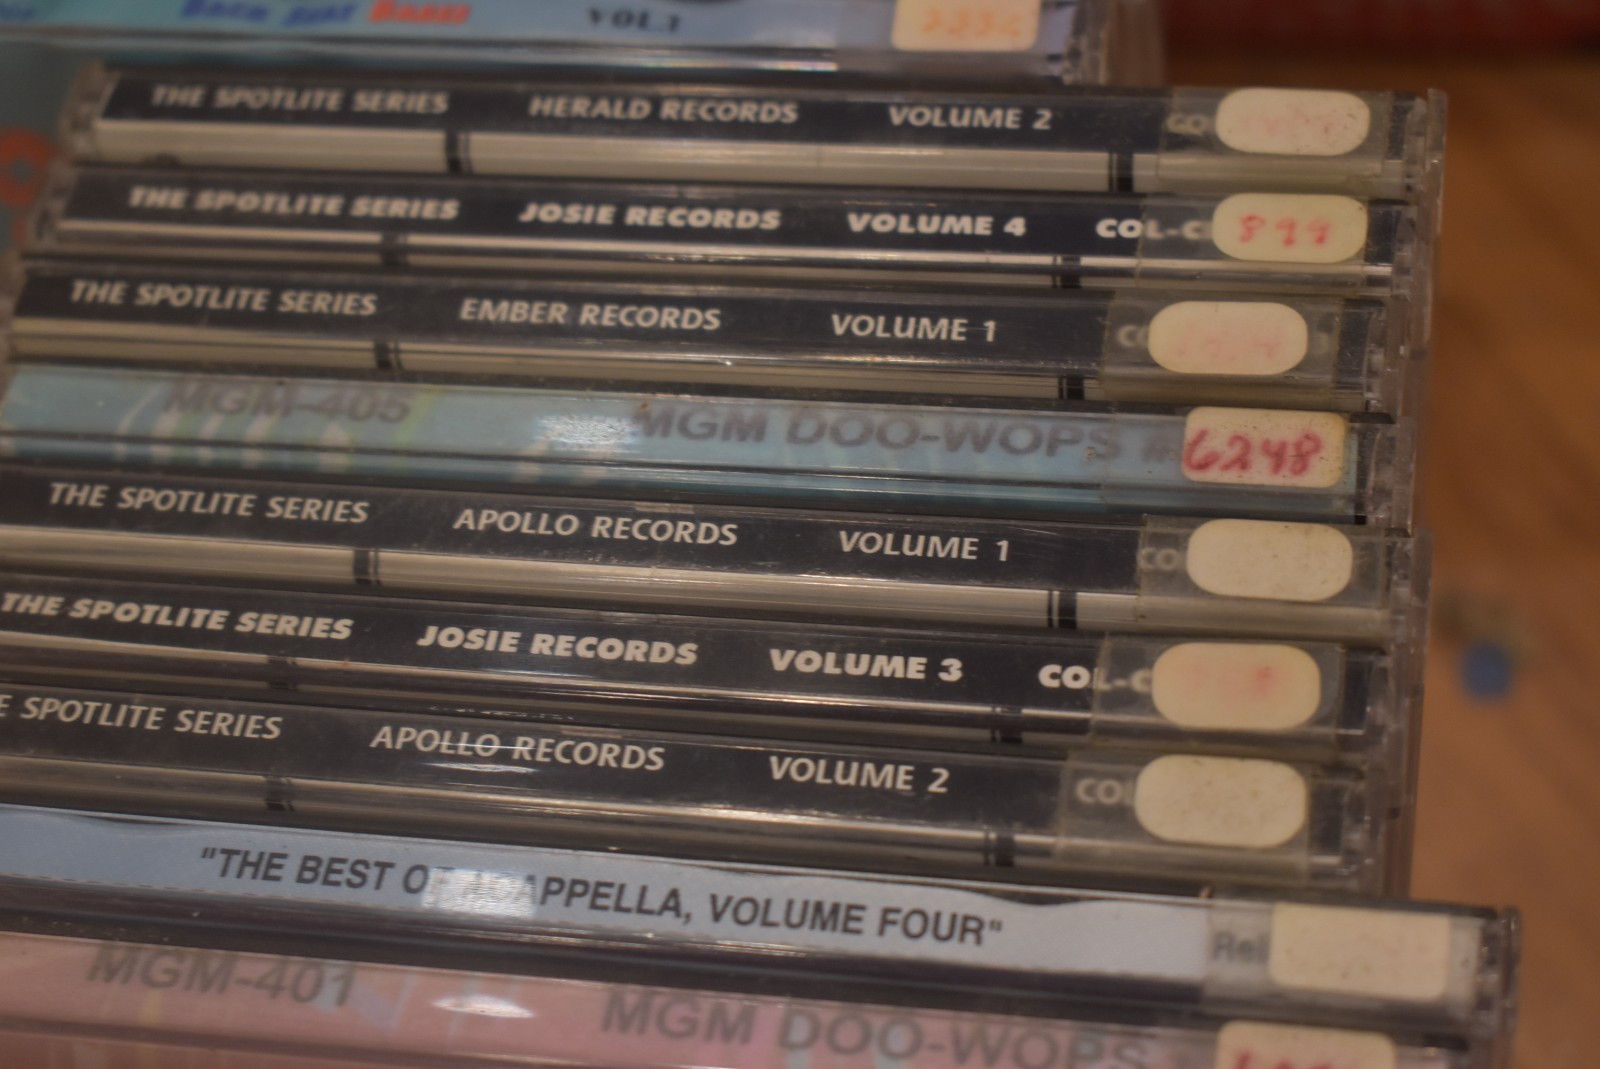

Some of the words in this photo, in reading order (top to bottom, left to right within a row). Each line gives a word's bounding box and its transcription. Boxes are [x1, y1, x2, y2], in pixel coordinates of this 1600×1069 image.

[153, 85, 205, 107] THE
[216, 87, 343, 111] SPOTLITE
[354, 91, 448, 113] SERIES
[530, 97, 651, 119] HERALD
[661, 99, 797, 123] RECORDS
[890, 106, 1021, 128] VOLUME
[1033, 109, 1052, 129] 2
[130, 187, 187, 208] THE
[195, 190, 344, 215] SPOTLITE
[351, 197, 459, 219] SERIES
[520, 203, 615, 224] JOSIE
[625, 207, 780, 229] RECORDS
[848, 213, 993, 235] VOLUME
[1004, 217, 1026, 236] 4
[72, 280, 127, 304] THE
[136, 284, 270, 311] SPOTLITE
[279, 291, 377, 315] SERIES
[460, 299, 569, 324] EMBER
[579, 304, 720, 330] RECORDS
[832, 314, 968, 340] VOLUME
[984, 321, 995, 342] 1
[163, 380, 412, 427] MGM-405
[632, 404, 768, 444] MGM
[784, 411, 1123, 461] DOO-WOPS
[1182, 428, 1322, 476] 6248
[51, 483, 108, 507] THE
[118, 488, 257, 516] SPOTLITE
[266, 497, 369, 523] SERIES
[454, 509, 579, 535] APOLLO
[592, 516, 737, 545] RECORDS
[840, 531, 978, 559] VOLUME
[997, 540, 1008, 561] 1
[2, 593, 64, 615] THE
[69, 599, 229, 630] SPOTLITE
[235, 612, 353, 639] SERIES
[417, 626, 521, 652] JOSIE
[530, 634, 698, 664] RECORDS
[770, 649, 927, 679] VOLUME
[939, 658, 962, 681] 3
[21, 697, 166, 729] SPOTLITE
[174, 710, 282, 739] SERIES
[370, 726, 501, 757] APOLLO
[511, 736, 665, 772] RECORDS
[770, 756, 914, 790] VOLUME
[928, 768, 949, 792] 2
[201, 847, 288, 881] "THE
[296, 855, 395, 890] BEST
[710, 894, 866, 935] VOLUME
[878, 907, 1002, 946] FOUR"
[86, 944, 359, 1006] MGM-401
[600, 990, 754, 1044] MGM
